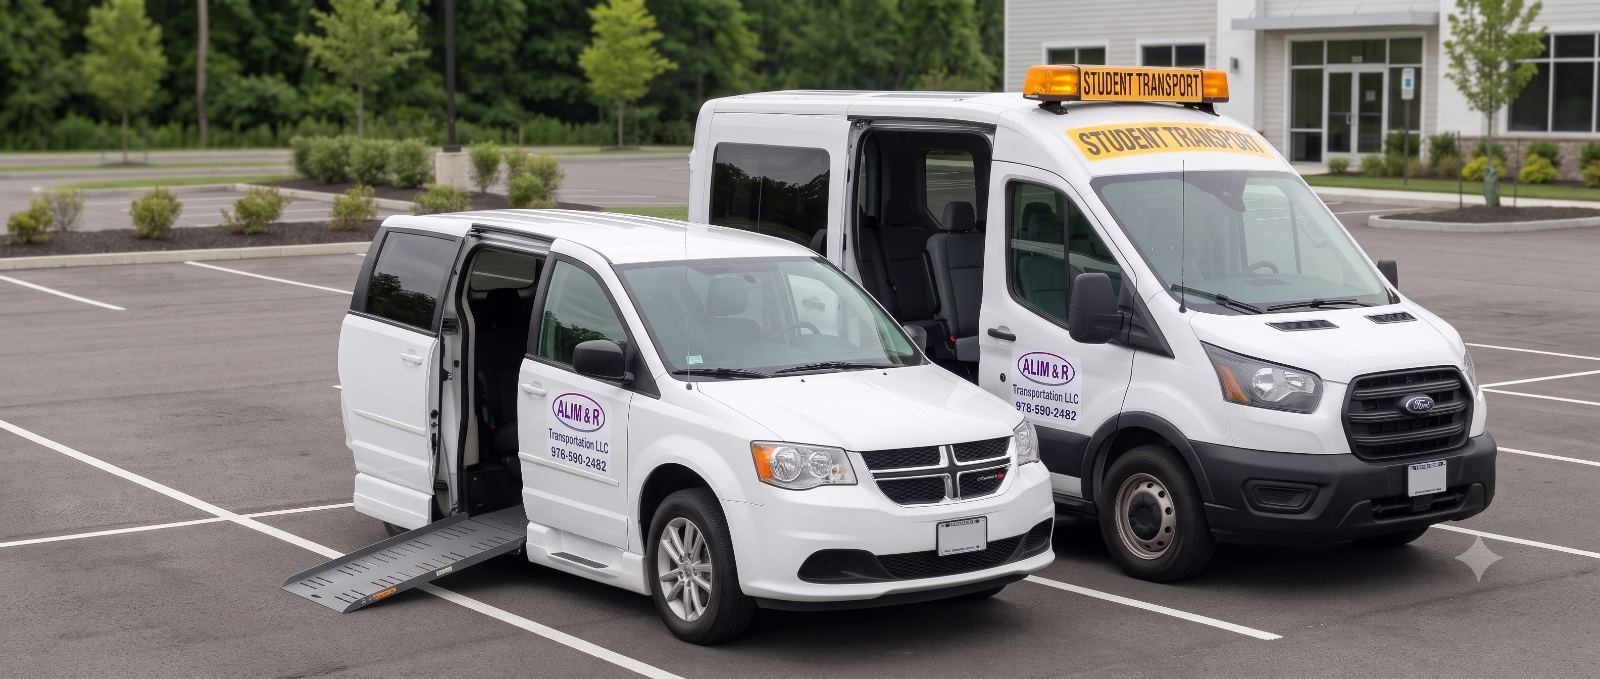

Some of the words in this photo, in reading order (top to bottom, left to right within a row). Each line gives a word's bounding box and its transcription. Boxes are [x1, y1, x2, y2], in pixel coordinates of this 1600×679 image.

[1083, 71, 1134, 96] STUDENT
[1136, 72, 1200, 97] TRANSPORT
[1078, 126, 1166, 155] STUDENT
[1161, 126, 1265, 154] TRANSPORT
[1022, 358, 1050, 377] ALIM
[1052, 364, 1059, 379] &
[1061, 364, 1069, 380] R
[1012, 383, 1063, 403] Transportation
[1064, 392, 1079, 404] LLC
[557, 399, 582, 422] ALIM
[583, 407, 591, 424] &
[592, 408, 600, 426] R
[1015, 401, 1077, 421] 978-590-2482
[548, 427, 595, 450] Transportation
[595, 439, 609, 454] LLC
